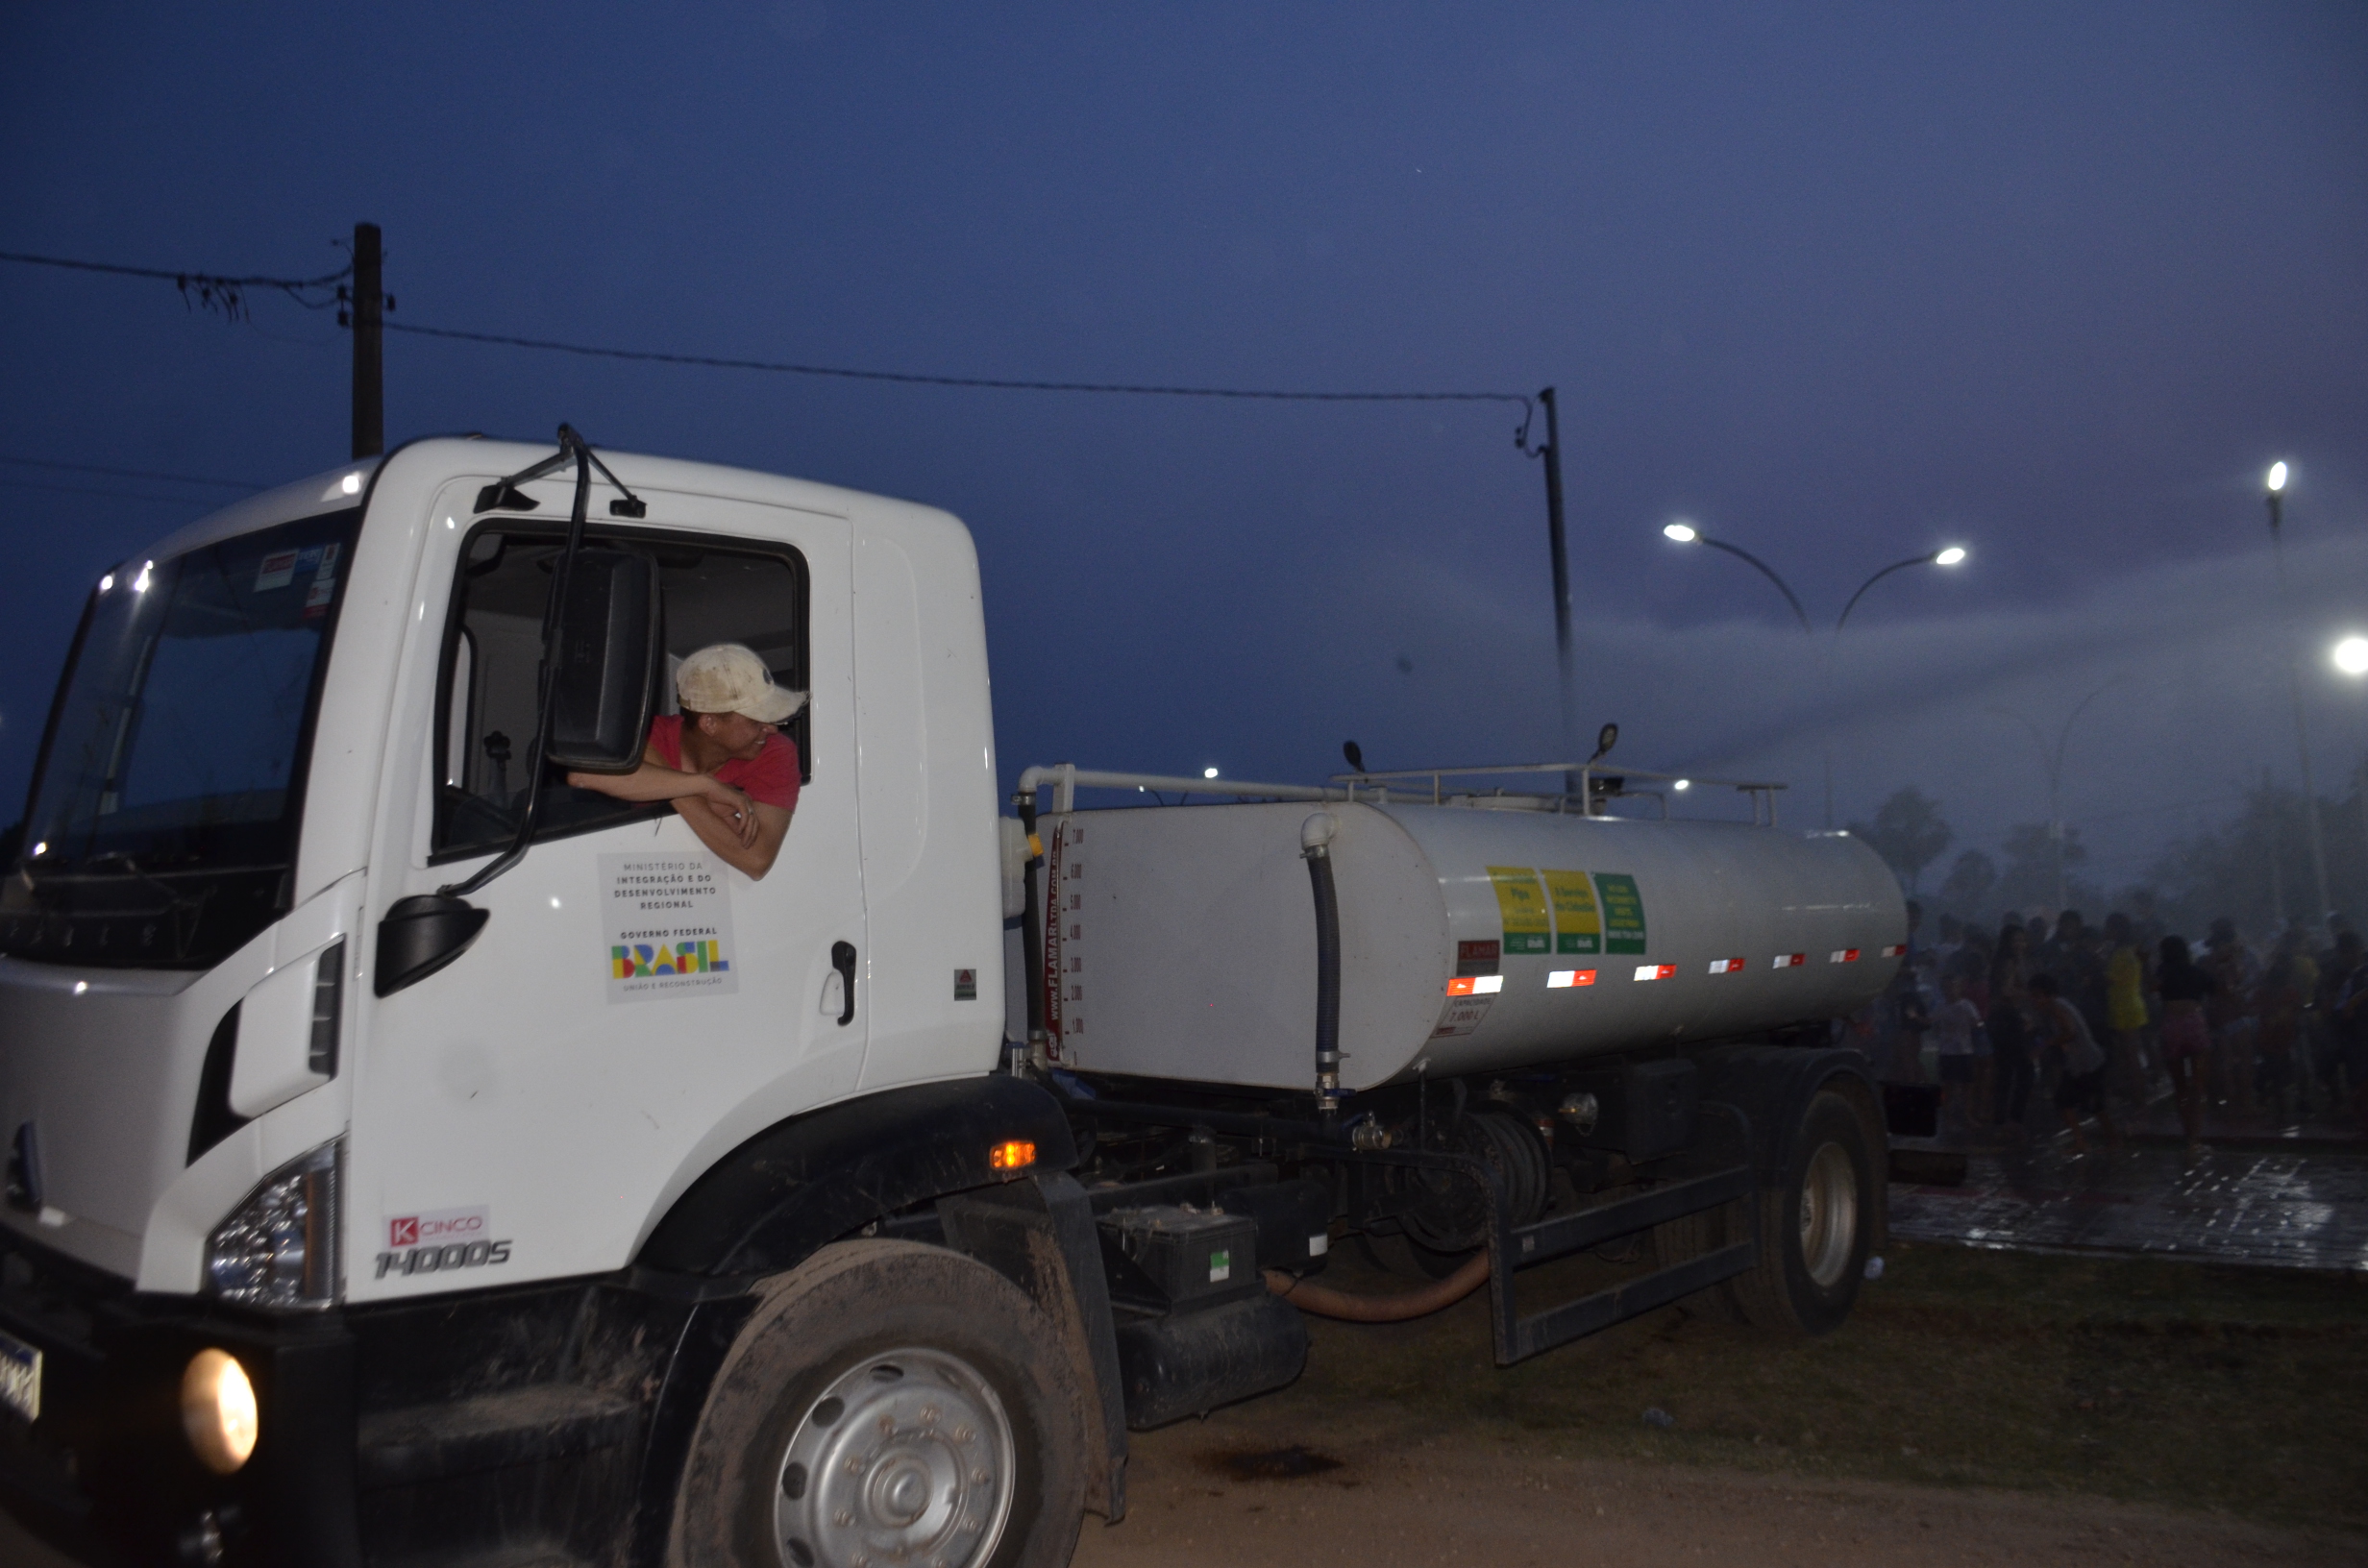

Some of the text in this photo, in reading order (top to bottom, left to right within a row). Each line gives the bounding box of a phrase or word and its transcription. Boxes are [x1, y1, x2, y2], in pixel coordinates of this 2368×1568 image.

[623, 861, 703, 871] MINISTÉRIO DA
[617, 874, 683, 885] INTEGRAÇÃO
[614, 887, 716, 898] DESENVOLVIMENTO
[640, 901, 694, 910] REGIONAL
[620, 927, 718, 940] GOVERNO FEDERAL
[611, 940, 730, 979] BRASIL
[624, 981, 649, 992] UNIÃO
[659, 977, 723, 989] RECONSTRUÇÃO
[420, 1215, 483, 1236] CINCO
[374, 1239, 513, 1280] 14000S
